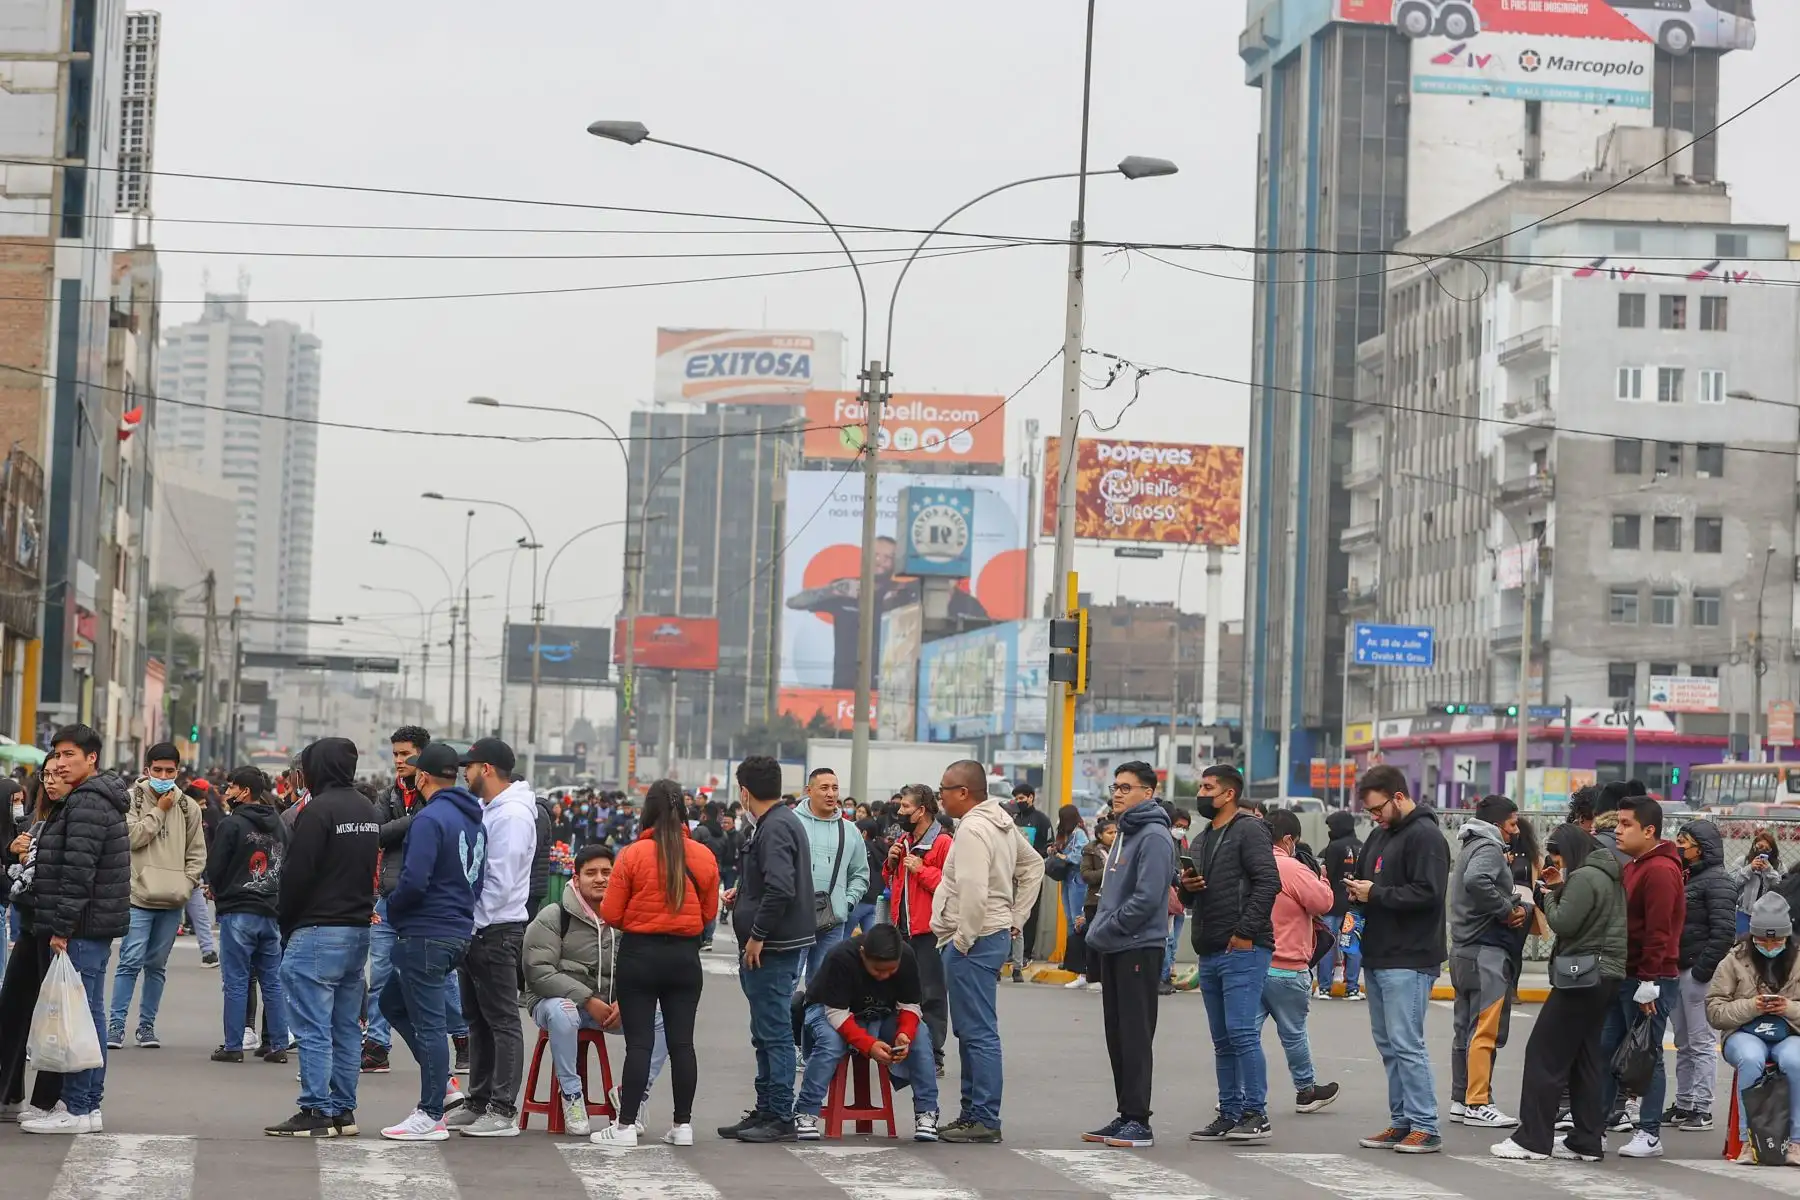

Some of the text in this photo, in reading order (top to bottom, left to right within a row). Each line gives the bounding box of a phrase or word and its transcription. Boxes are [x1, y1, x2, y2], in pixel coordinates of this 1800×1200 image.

[1547, 56, 1645, 76] Marcopolo
[685, 351, 811, 379] EXITOSA
[834, 398, 980, 423] falbella.com
[336, 823, 355, 834] MUSIC
